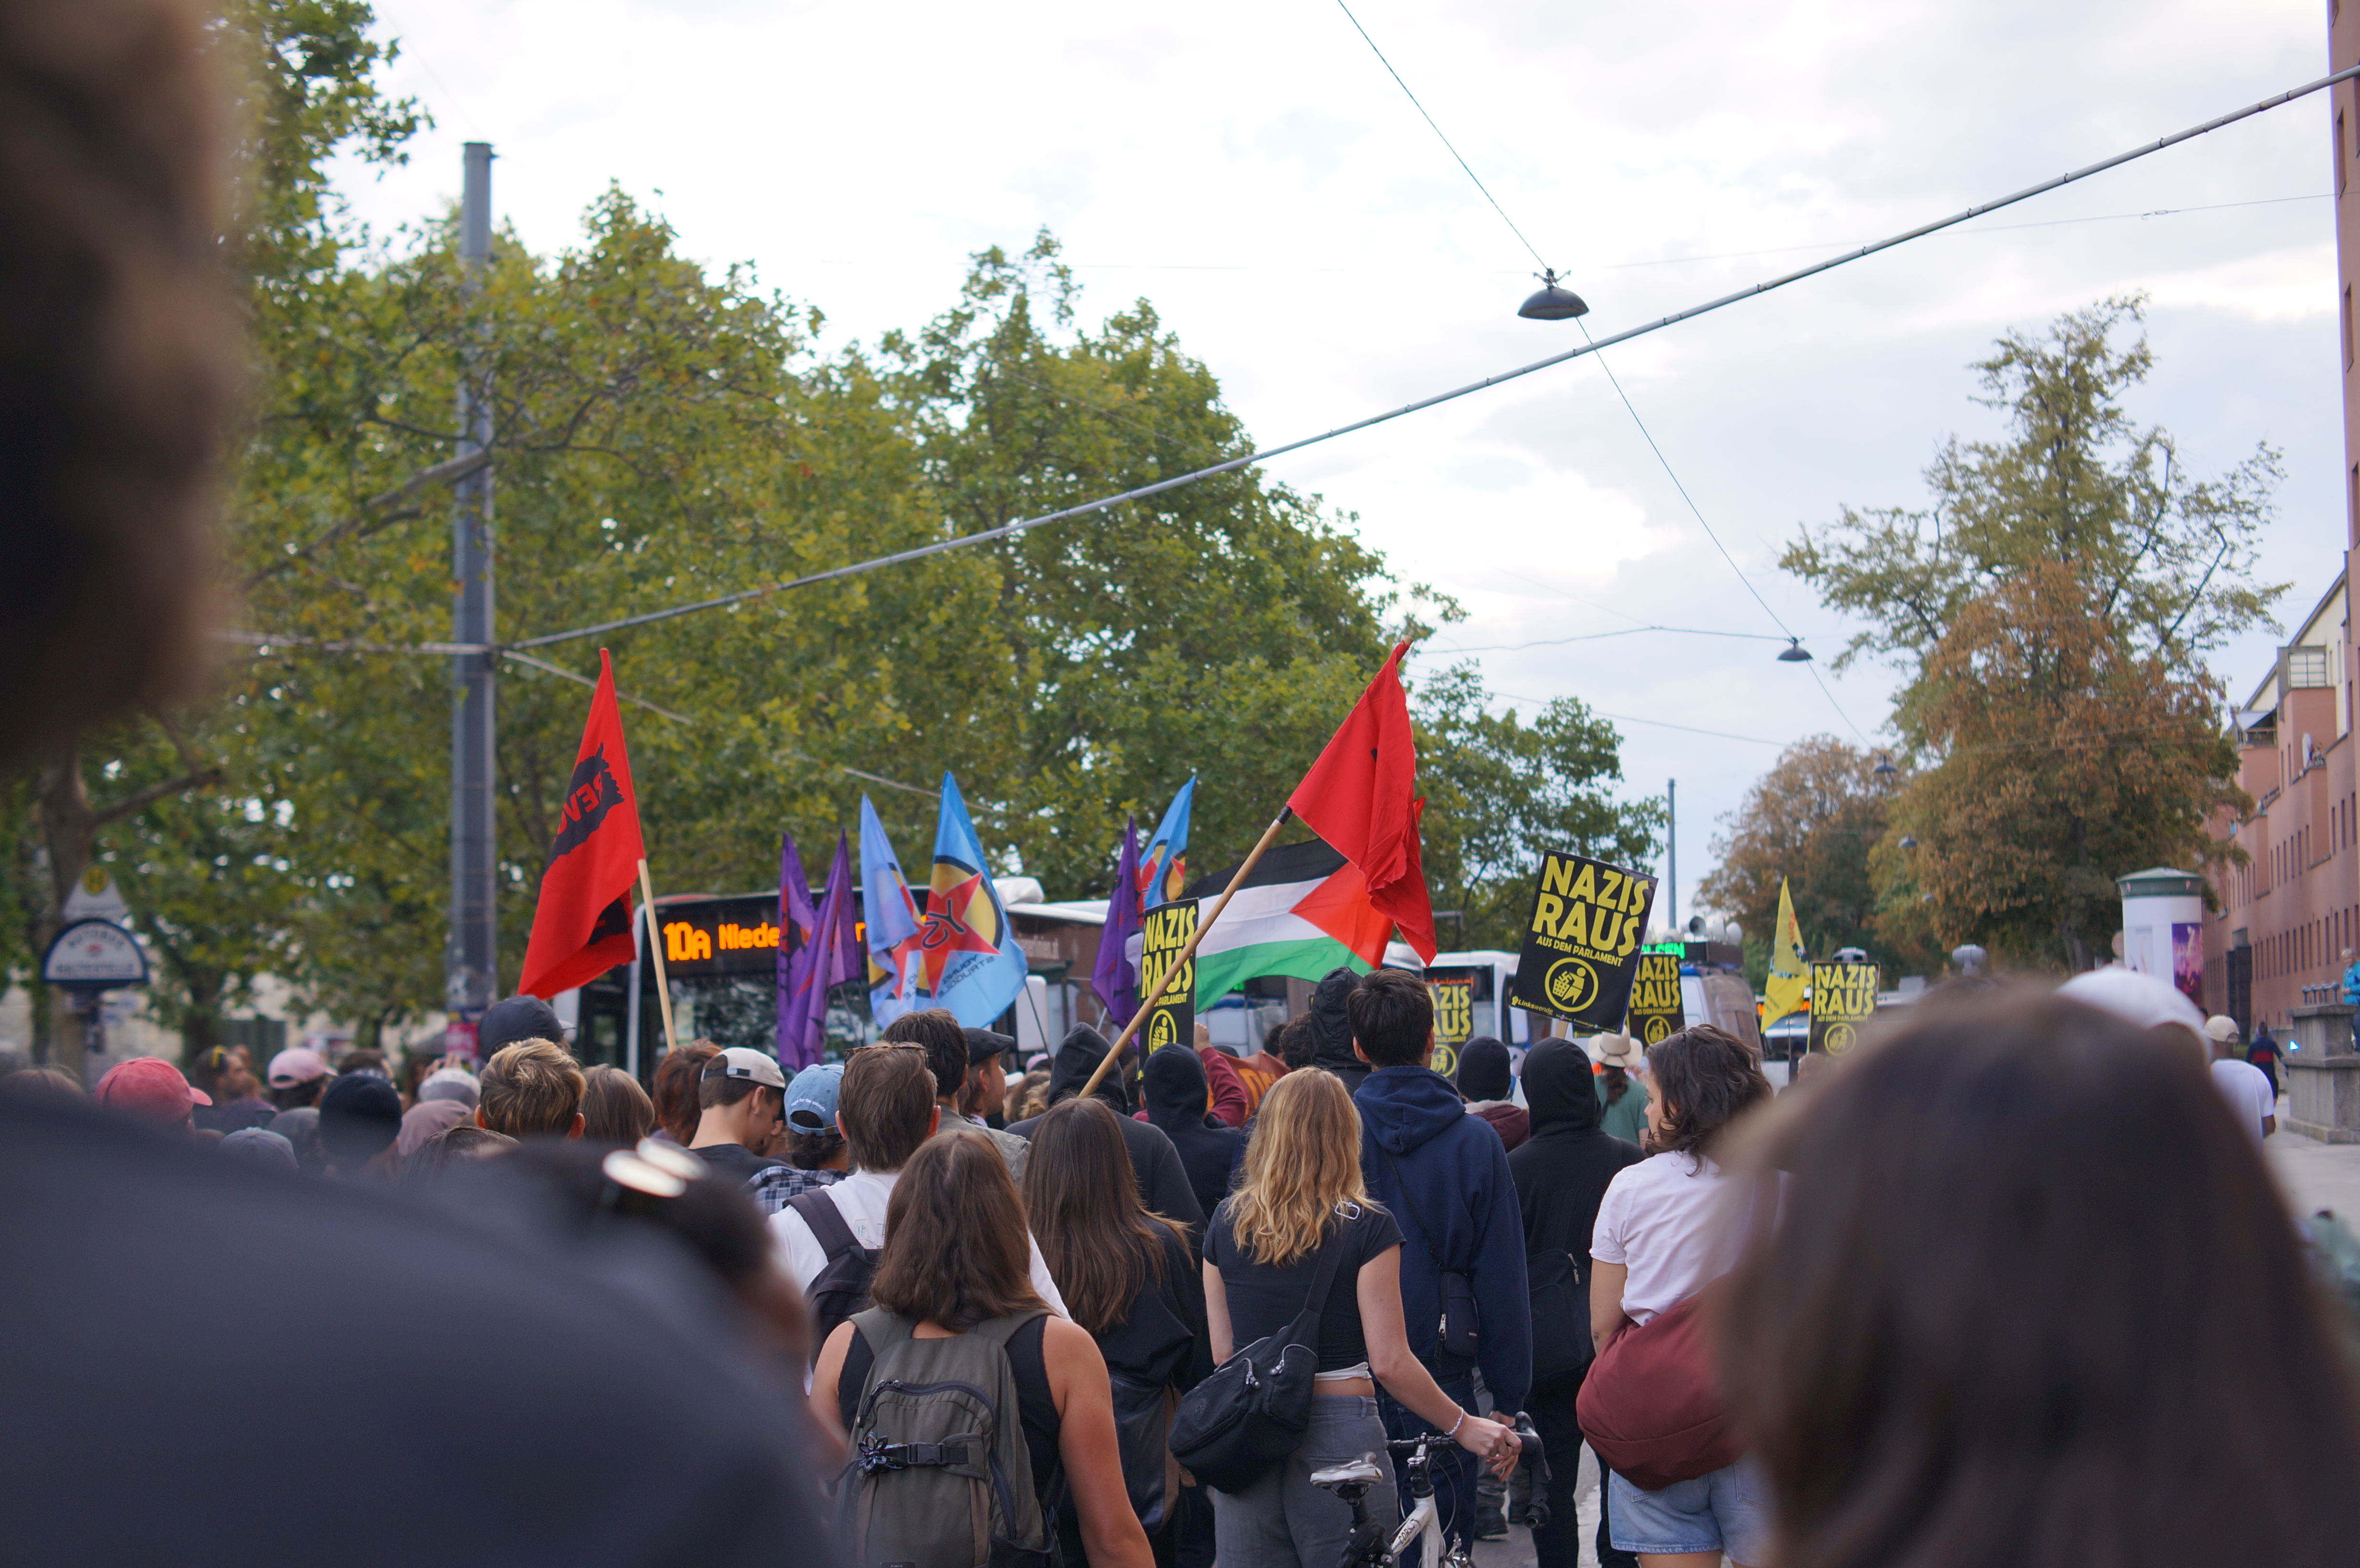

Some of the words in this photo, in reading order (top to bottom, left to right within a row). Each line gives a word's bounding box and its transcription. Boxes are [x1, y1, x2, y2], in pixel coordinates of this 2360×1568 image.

[1541, 856, 1649, 916] NAZIS
[1143, 906, 1196, 954] NAZIS
[1532, 892, 1639, 956] RAUS
[663, 922, 711, 961] 10A
[1536, 935, 1552, 947] AUS
[1553, 940, 1572, 953] DEM
[1573, 945, 1623, 967] PARLAMENT
[1141, 949, 1193, 998] RAUS
[1814, 964, 1876, 989] NAZIS
[1158, 993, 1187, 1006] PARLAMENT
[1518, 999, 1553, 1015] Linkswende
[1630, 980, 1680, 1008] RAUS
[1814, 988, 1874, 1016] RAUS
